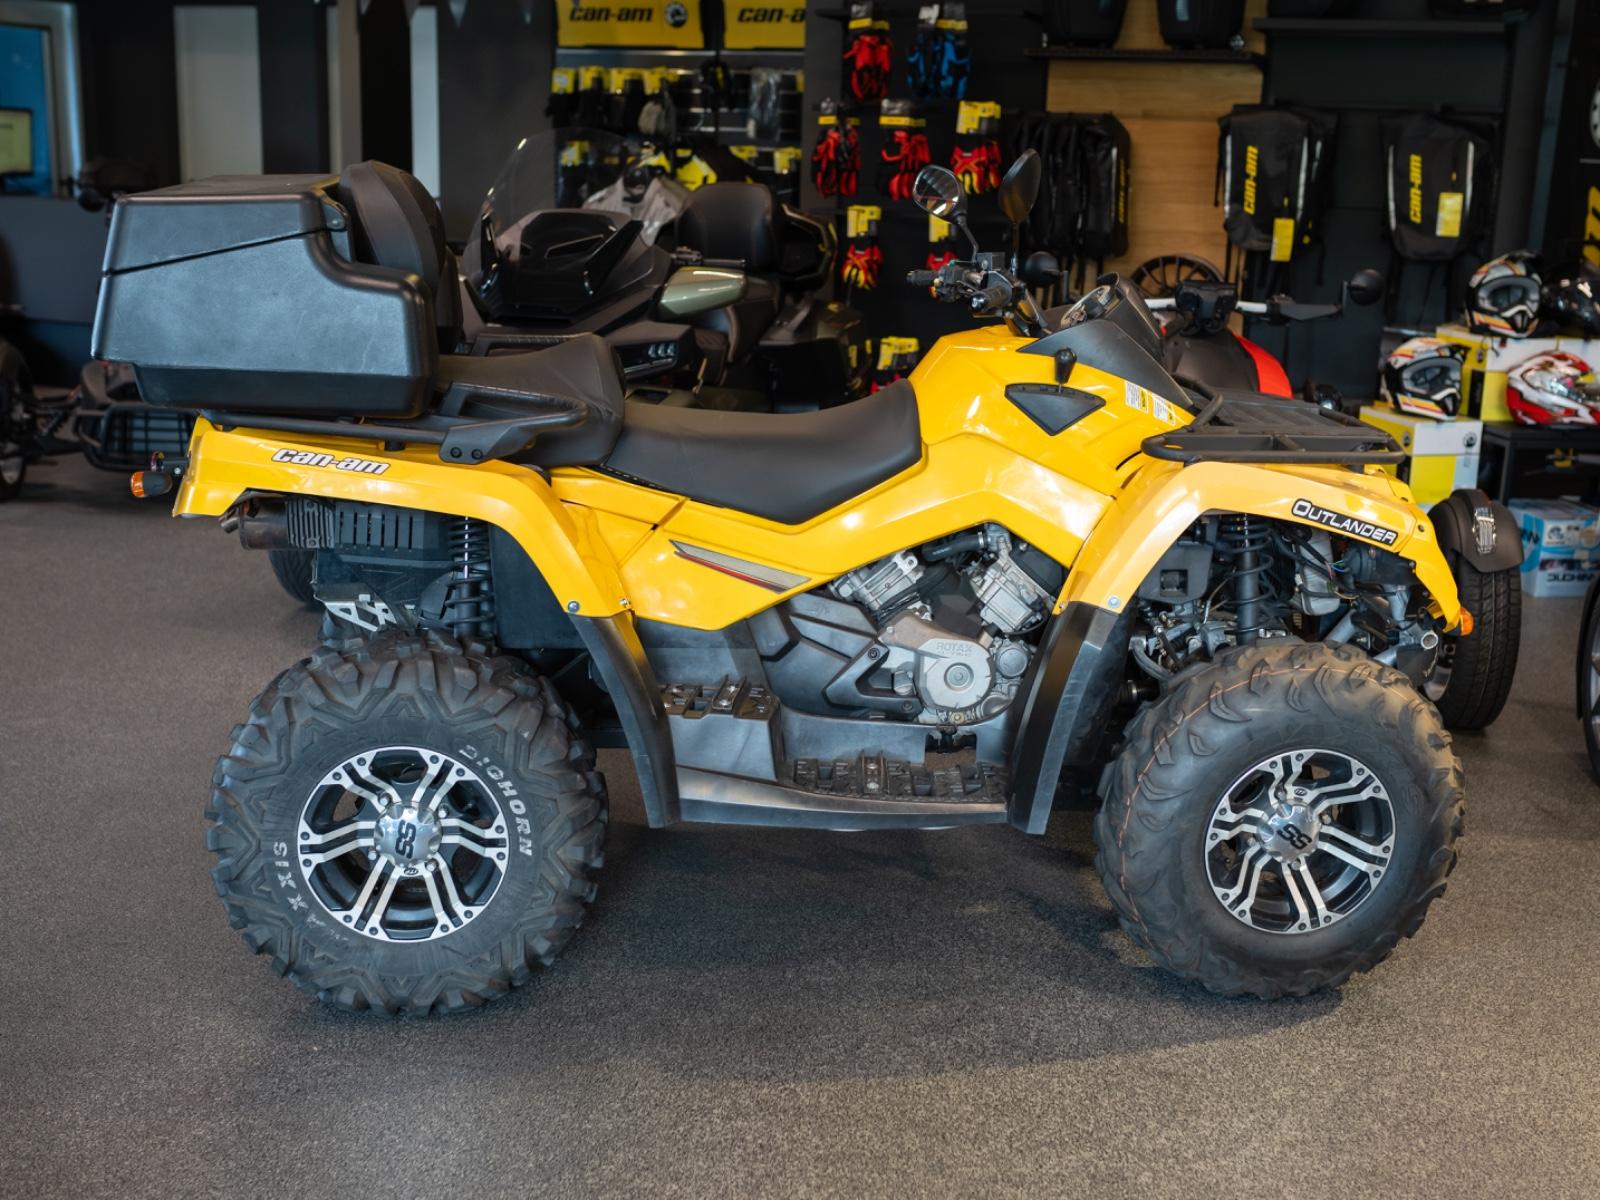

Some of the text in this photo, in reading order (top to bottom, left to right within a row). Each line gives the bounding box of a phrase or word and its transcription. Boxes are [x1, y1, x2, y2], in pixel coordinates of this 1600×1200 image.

[570, 8, 653, 22] can-am
[1244, 145, 1258, 214] can-am
[1409, 154, 1422, 224] can-am
[272, 448, 390, 475] can-am
[1291, 499, 1397, 545] OUTLANDER
[936, 642, 973, 653] ROTAX
